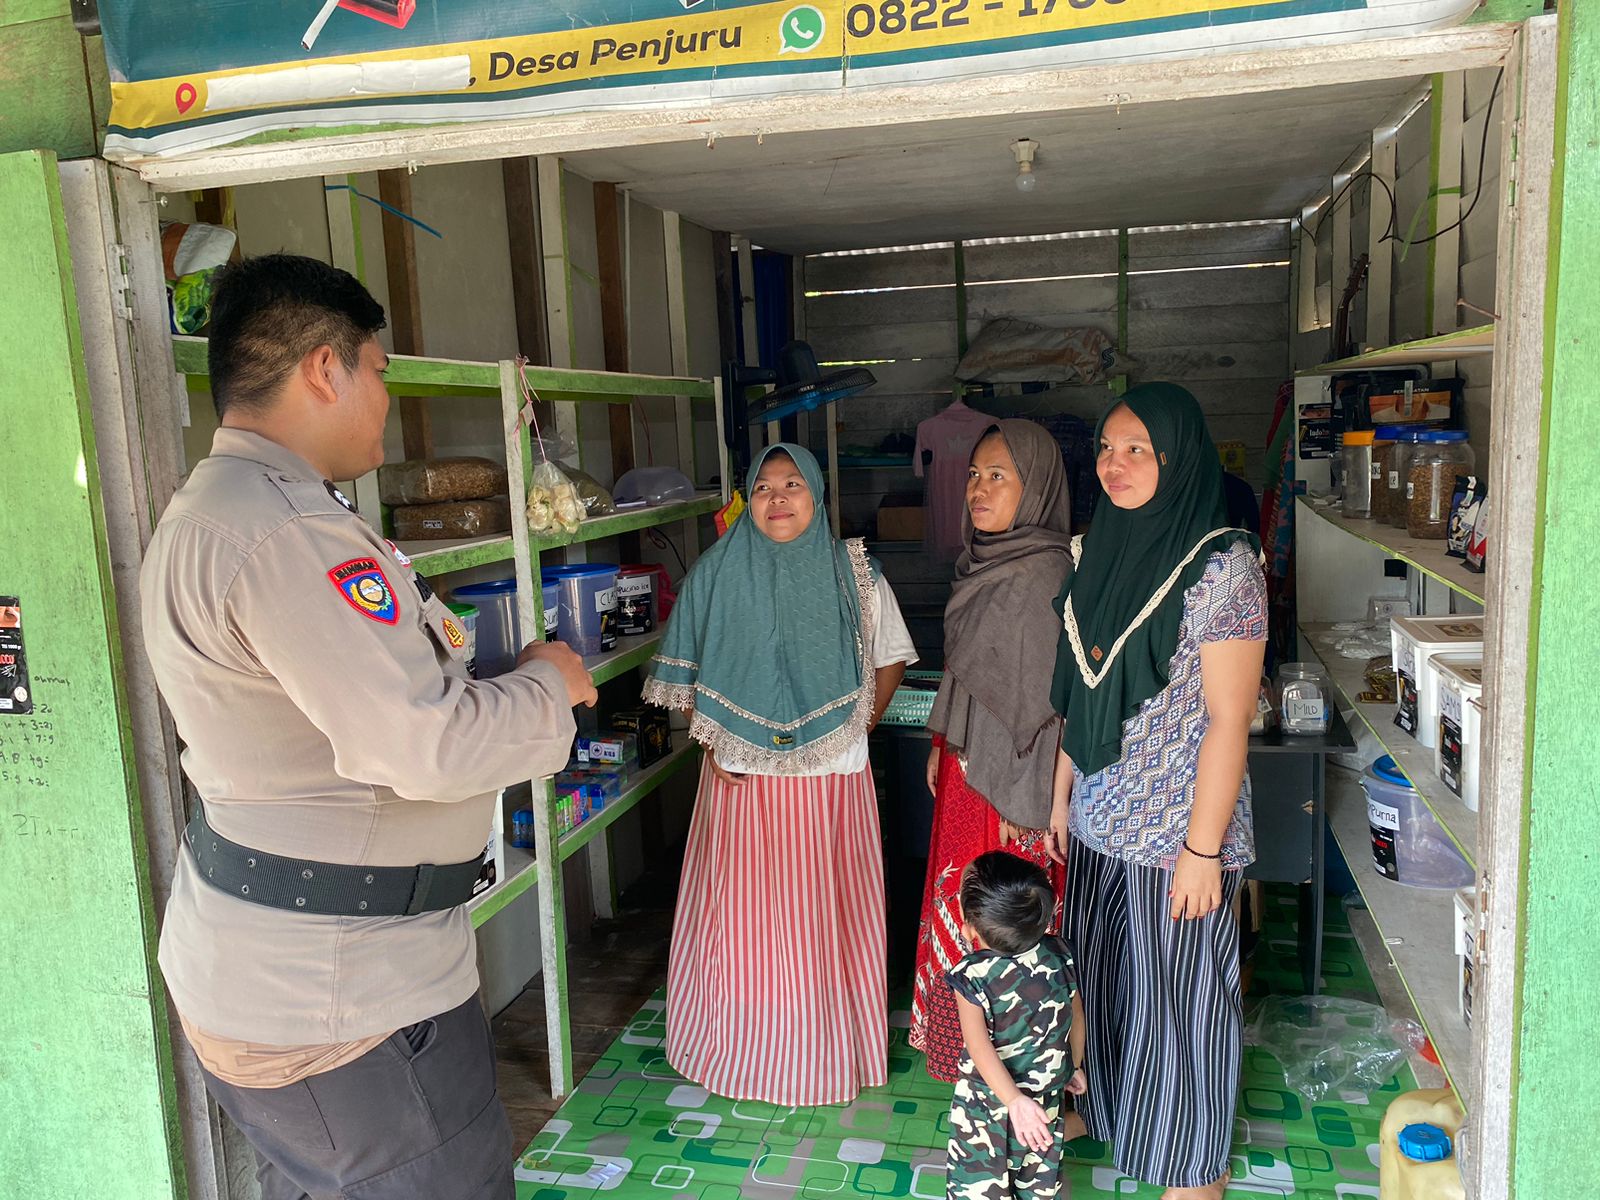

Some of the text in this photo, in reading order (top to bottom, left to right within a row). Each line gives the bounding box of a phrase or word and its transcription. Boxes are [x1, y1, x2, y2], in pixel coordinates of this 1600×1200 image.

[846, 0, 970, 38] 0822
[488, 26, 742, 81] Desa Penjuru
[1293, 703, 1318, 715] MILD
